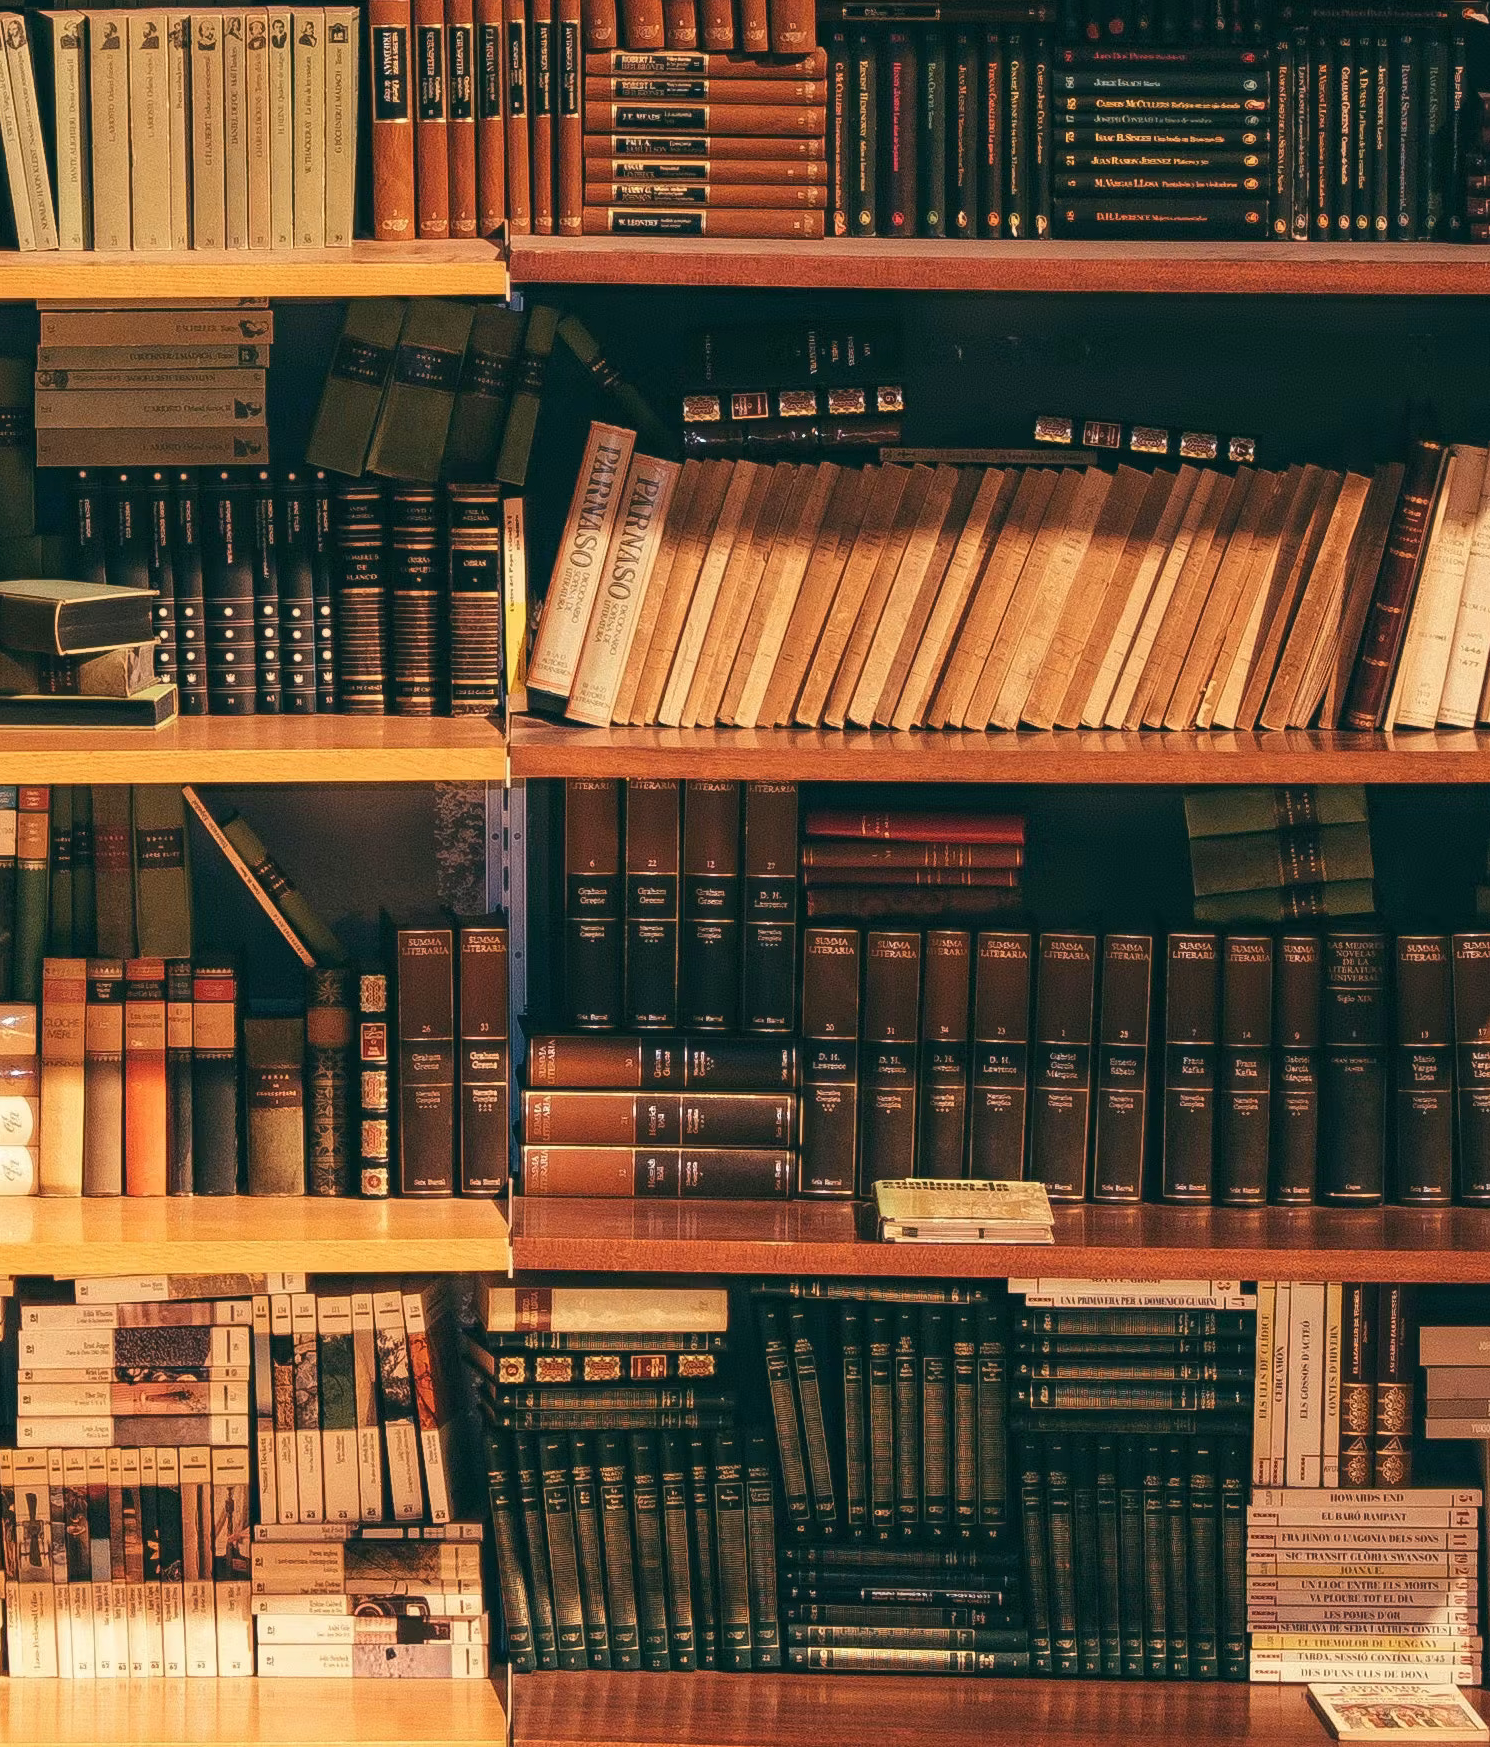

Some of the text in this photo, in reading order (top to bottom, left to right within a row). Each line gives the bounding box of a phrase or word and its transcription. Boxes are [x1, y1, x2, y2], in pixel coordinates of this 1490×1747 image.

[570, 444, 619, 568] PARNASO
[616, 476, 659, 599] PARNASO
[468, 936, 499, 944] SUMMA
[462, 944, 506, 953] LITERARIA
[469, 1051, 499, 1060] Graham
[471, 1061, 497, 1069] Greene
[1330, 1493, 1404, 1502] HOWARDS END
[1322, 1510, 1407, 1521] EL BARÓ RAMPANT
